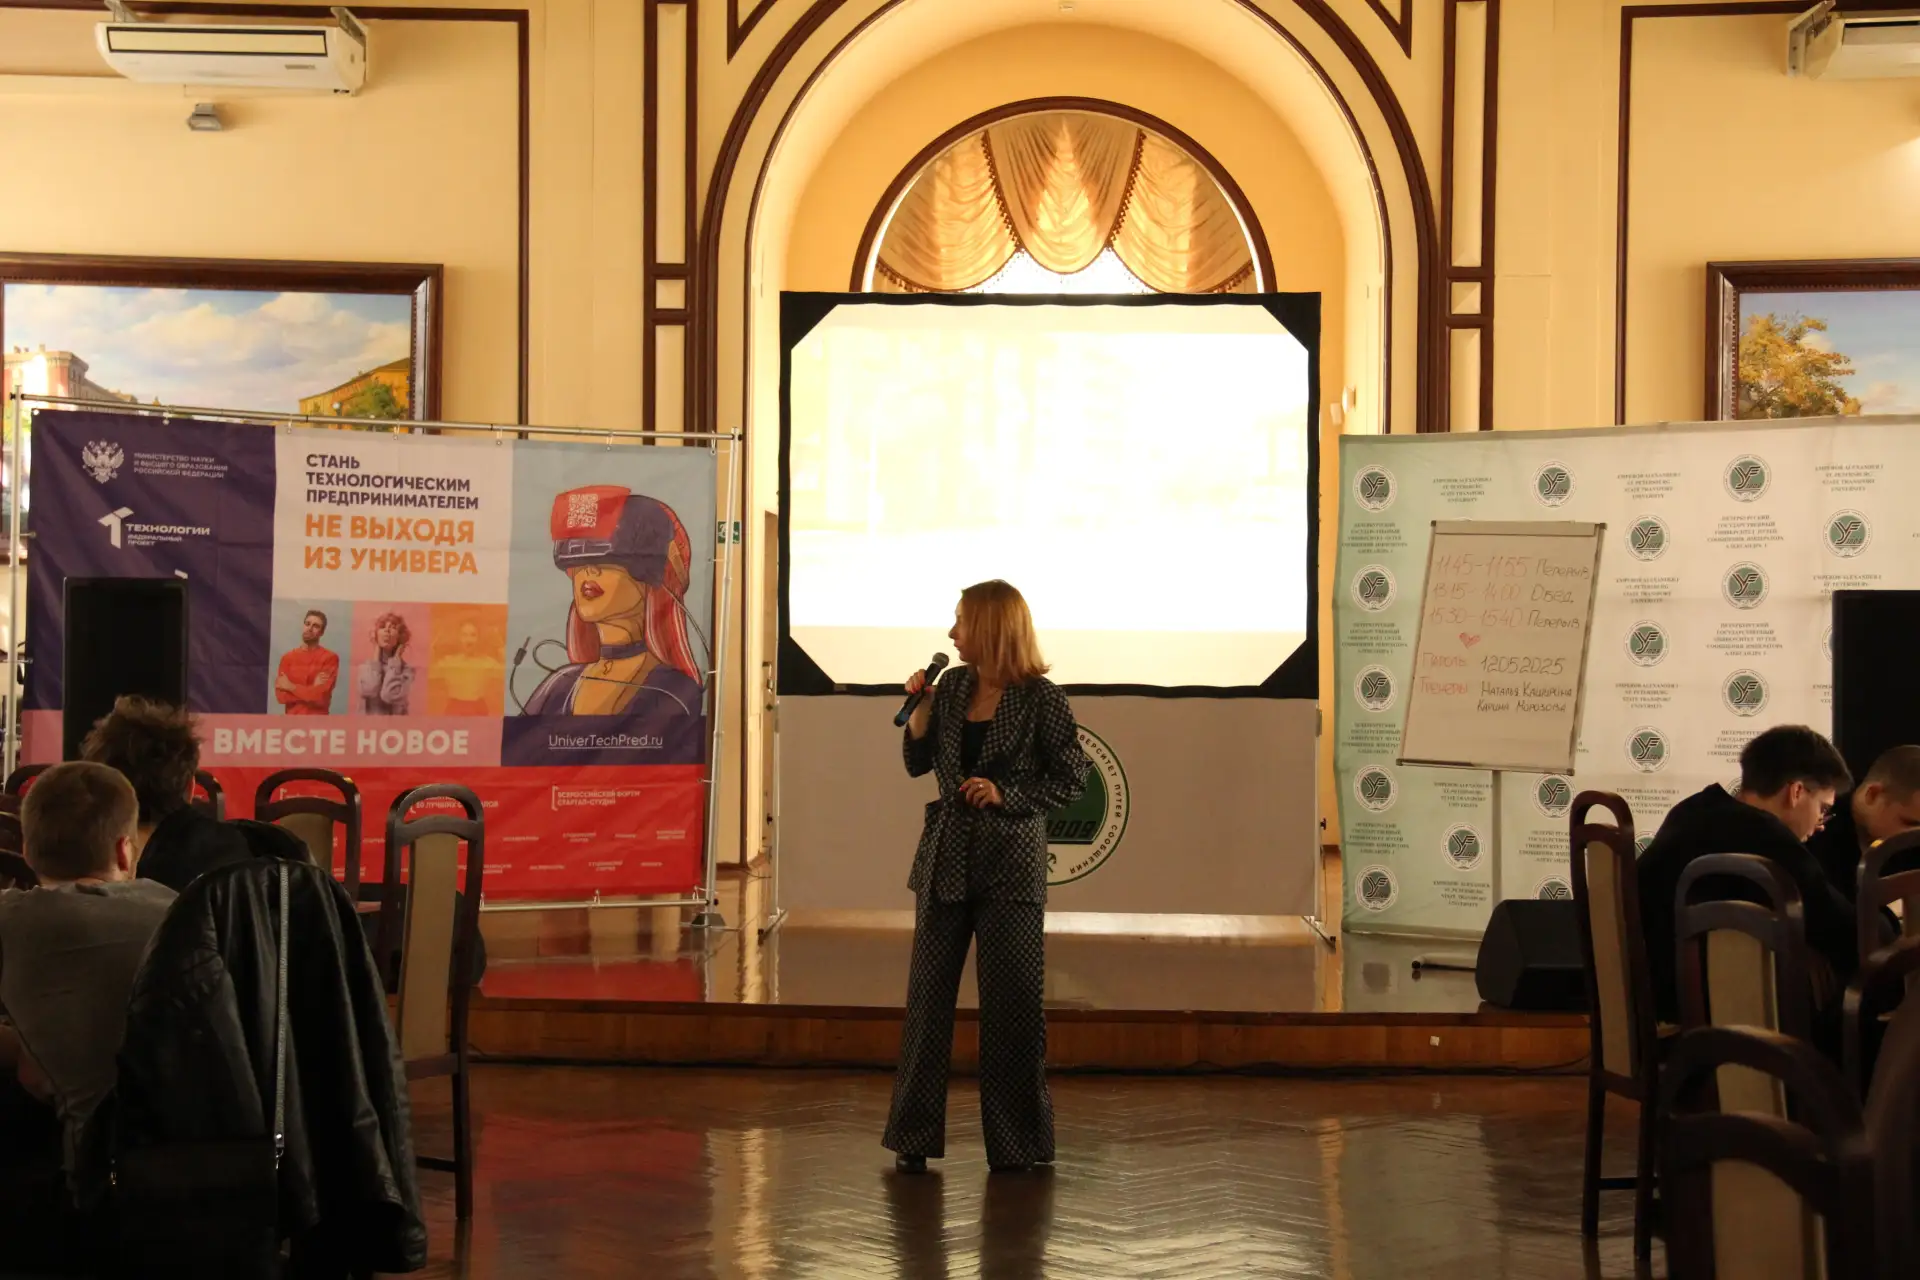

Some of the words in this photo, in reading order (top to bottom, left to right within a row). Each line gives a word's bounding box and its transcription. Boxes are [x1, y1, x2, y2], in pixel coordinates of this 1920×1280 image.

[134, 452, 190, 462] МИНИСТЕРСТВО
[140, 460, 175, 469] ВЫСШЕГО
[176, 463, 228, 471] ОБРАЗОВАНИЯ
[306, 454, 360, 469] СТАНЬ
[134, 467, 180, 476] РОССИЙСКОЙ
[182, 470, 224, 478] ФЕДЕРАЦИИ
[306, 472, 470, 492] ТЕХНОЛОГИЧЕСКИМ
[306, 490, 478, 510] ПРЕДПРИНИМАТЕЛЕМ
[126, 523, 210, 535] ТЕХНОЛОГИИ
[305, 514, 342, 538] НЕ
[351, 516, 474, 546] ВЫХОДЯ
[304, 546, 342, 570] ИЗ
[350, 548, 478, 574] УНИВЕРА
[1481, 655, 1566, 675] 12052025
[214, 728, 346, 754] ВМЕСТЕ
[356, 730, 470, 754] НОВОЕ
[549, 734, 663, 747] UniverTechPred.ru
[1079, 734, 1118, 777] ВЕРСИТЕТ
[1114, 784, 1122, 818] ПУТЕЙ
[1070, 824, 1118, 874] СООБЩЕНИЯ
